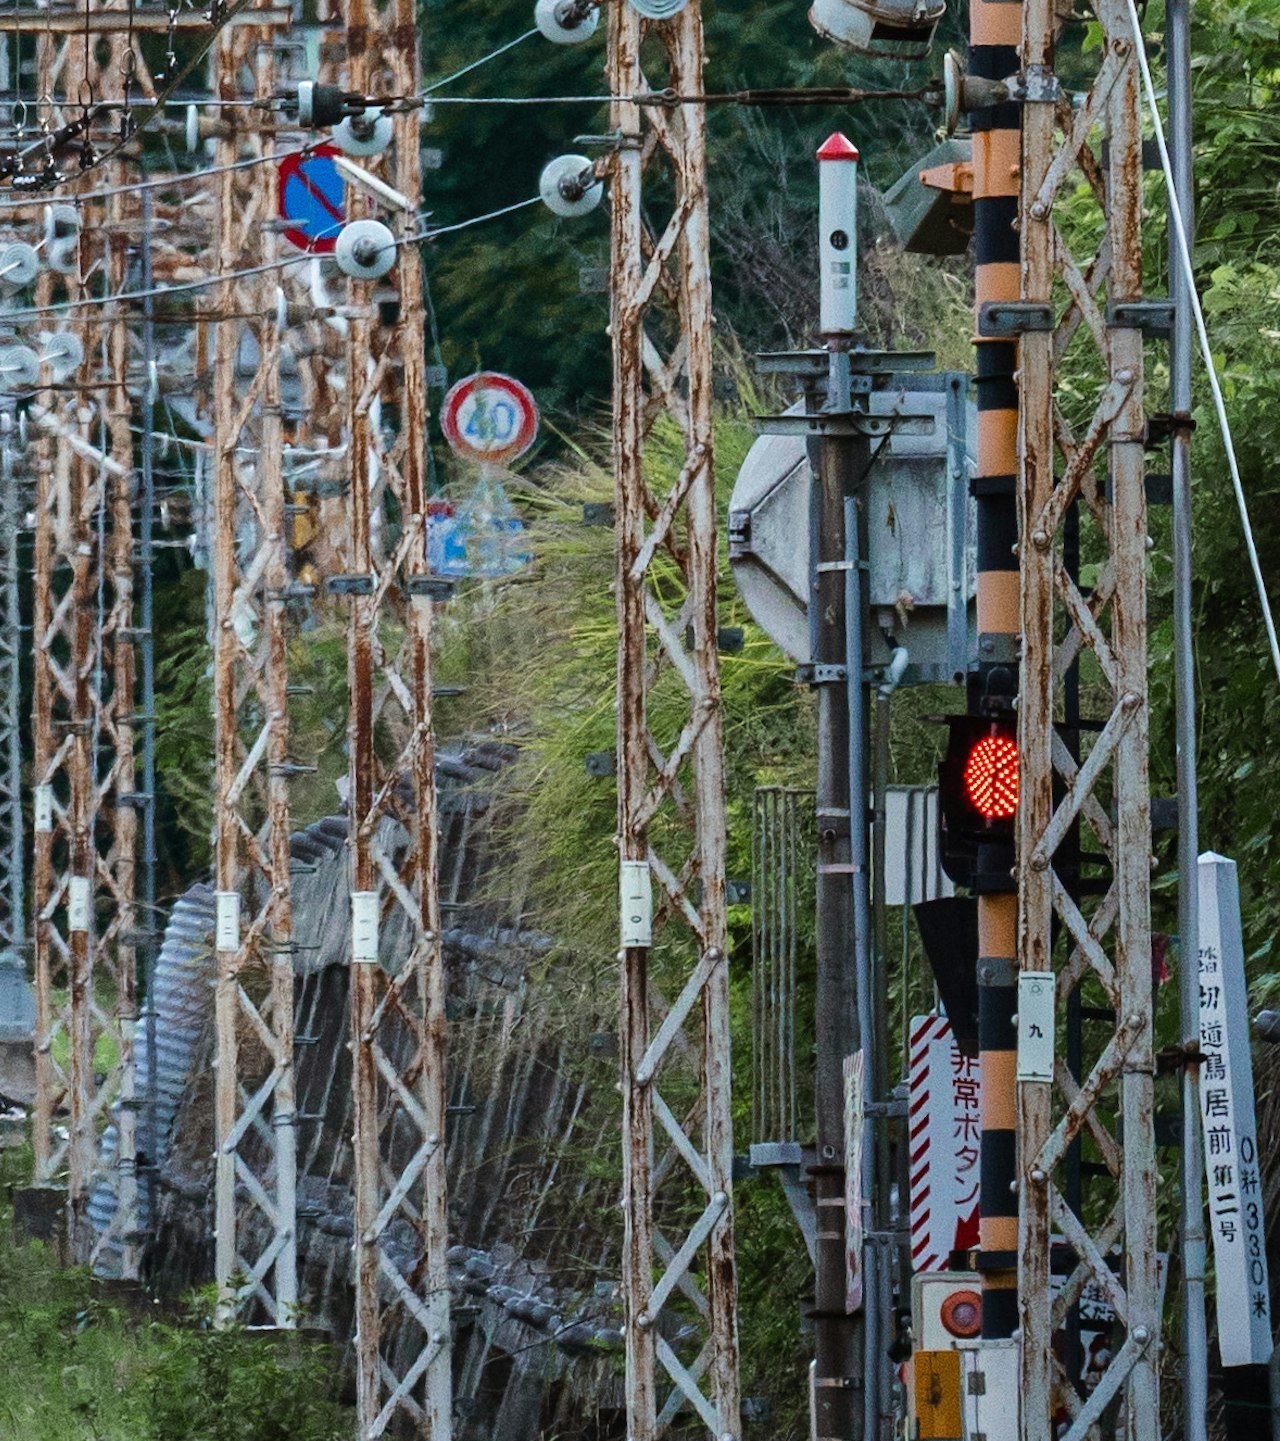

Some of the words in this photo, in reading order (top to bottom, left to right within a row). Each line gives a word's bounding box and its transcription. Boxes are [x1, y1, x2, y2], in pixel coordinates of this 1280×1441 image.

[1028, 1023, 1044, 1039] 九
[950, 1040, 981, 1205] 非常ボタン
